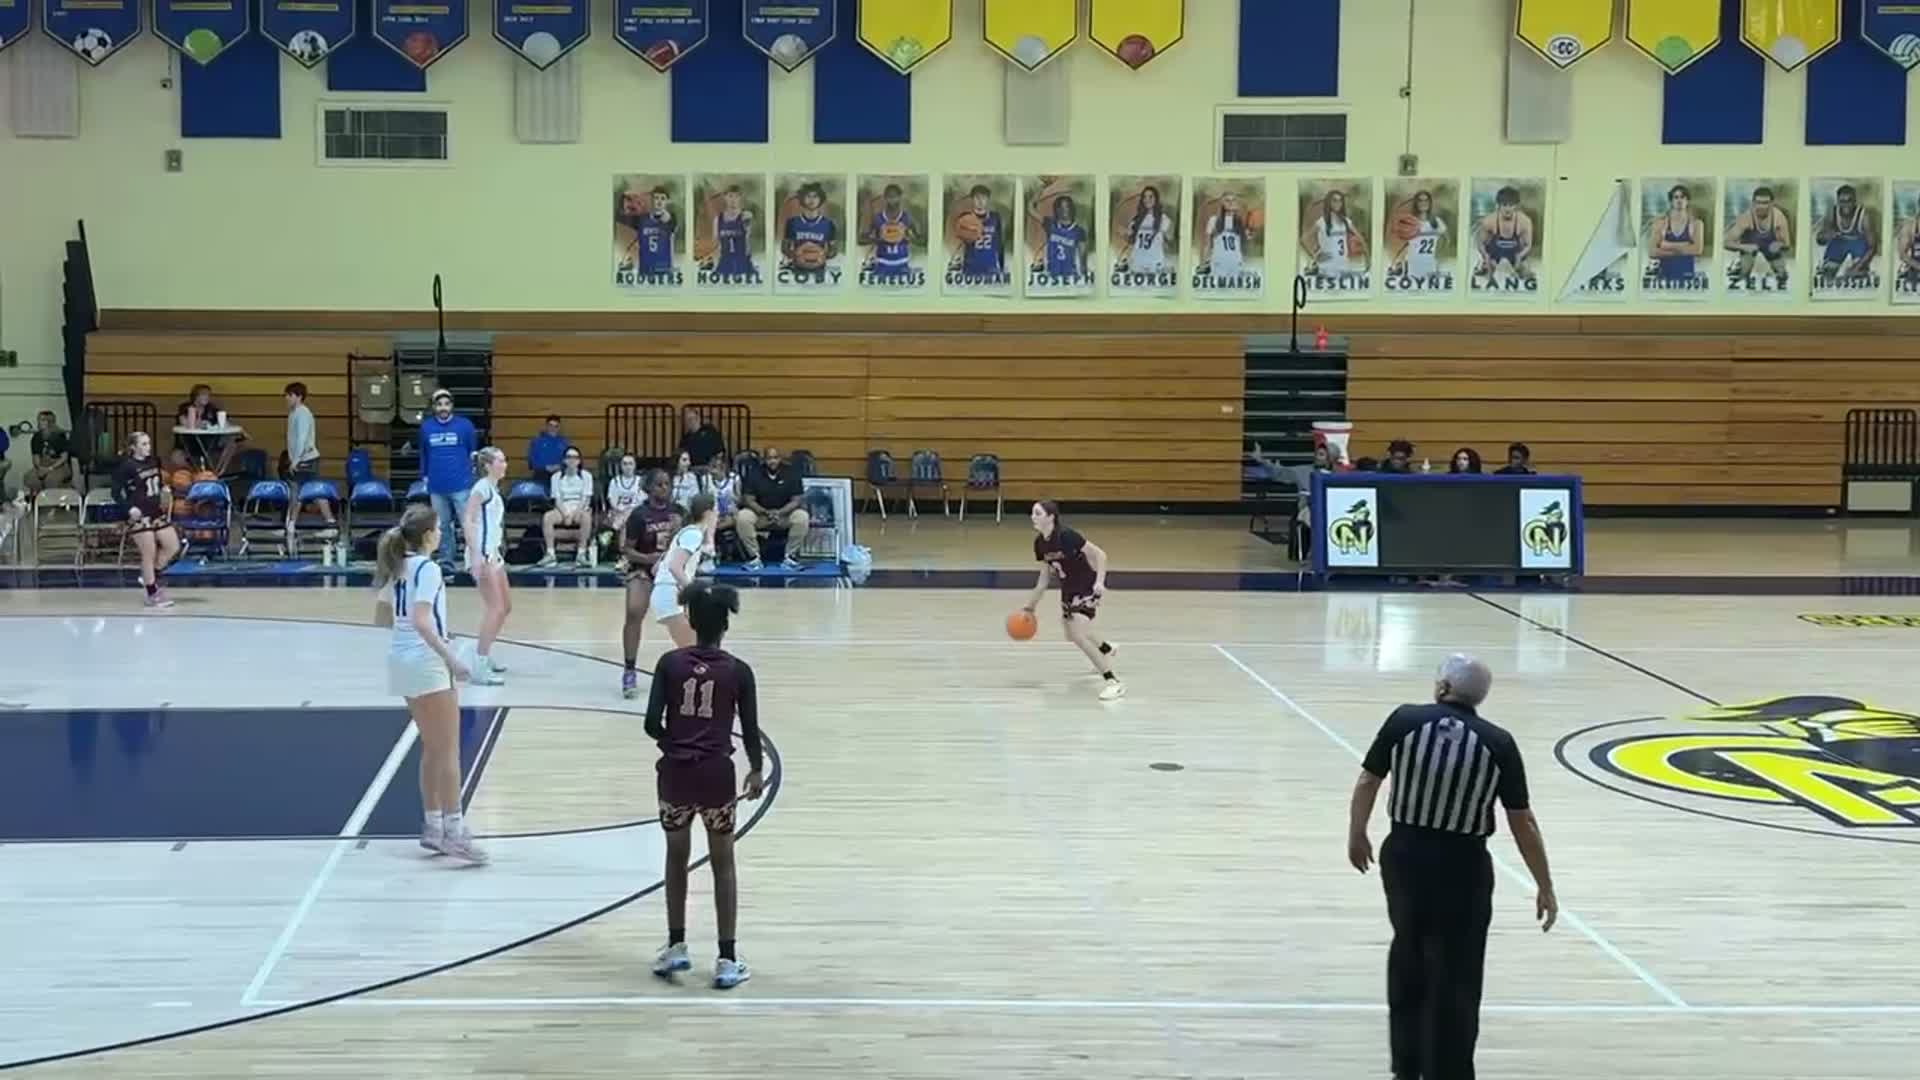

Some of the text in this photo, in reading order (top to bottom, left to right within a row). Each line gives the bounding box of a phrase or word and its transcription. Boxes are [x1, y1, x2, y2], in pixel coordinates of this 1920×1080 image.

[1056, 244, 1066, 260] 3
[1418, 238, 1435, 254] 22
[615, 271, 683, 285] RODGERS
[1028, 272, 1095, 287] JOSEPH
[1111, 272, 1177, 287] GEORGE
[1384, 275, 1454, 290] COYNE
[1470, 276, 1538, 291] LANG
[1727, 277, 1788, 291] ZELE
[394, 578, 407, 617] 11
[680, 677, 715, 718] 11
